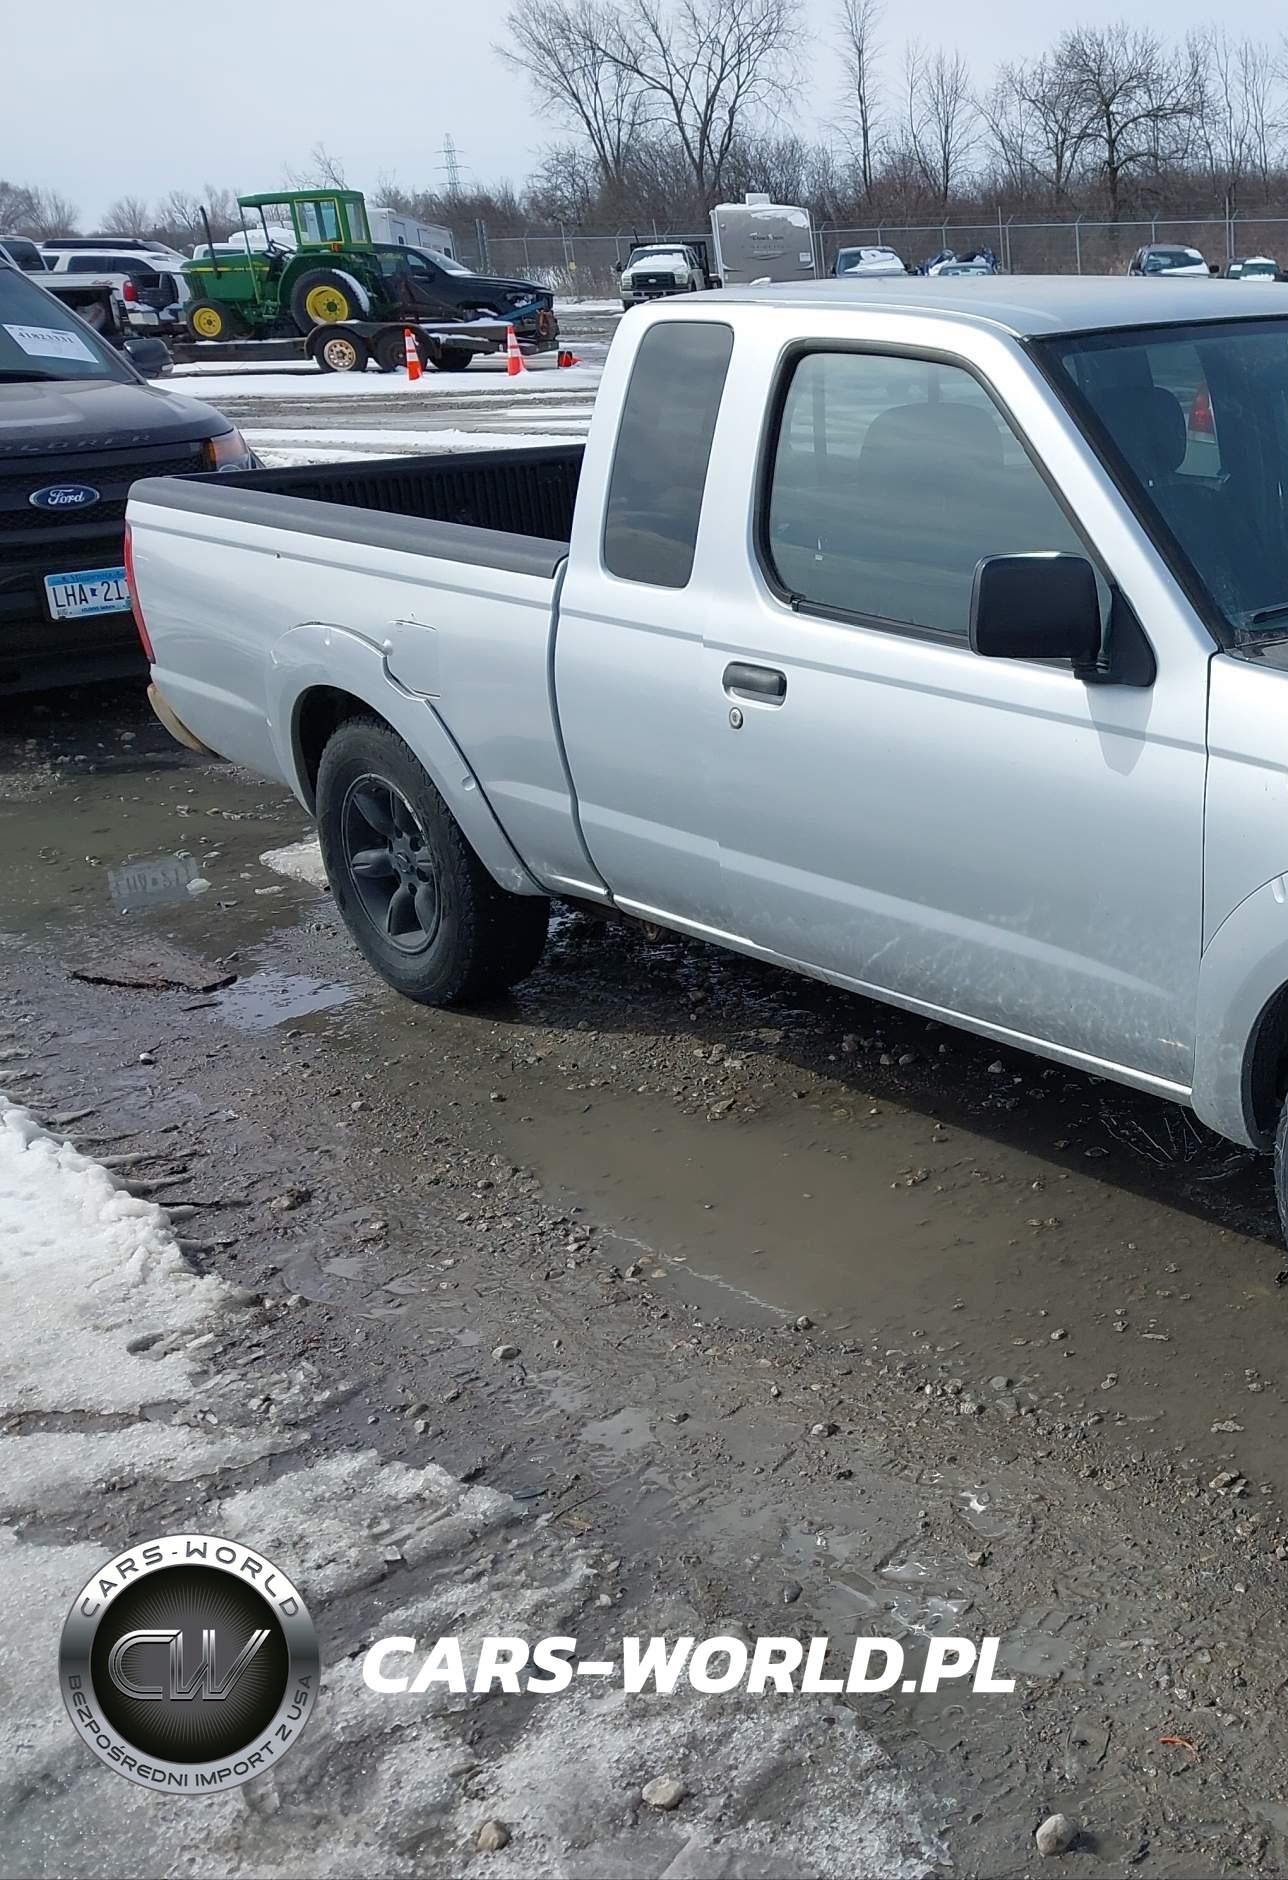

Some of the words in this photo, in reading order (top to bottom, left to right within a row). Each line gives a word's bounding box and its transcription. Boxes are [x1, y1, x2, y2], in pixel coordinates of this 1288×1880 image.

[47, 489, 86, 505] Ford
[53, 583, 89, 608] LHA
[101, 579, 131, 602] 21
